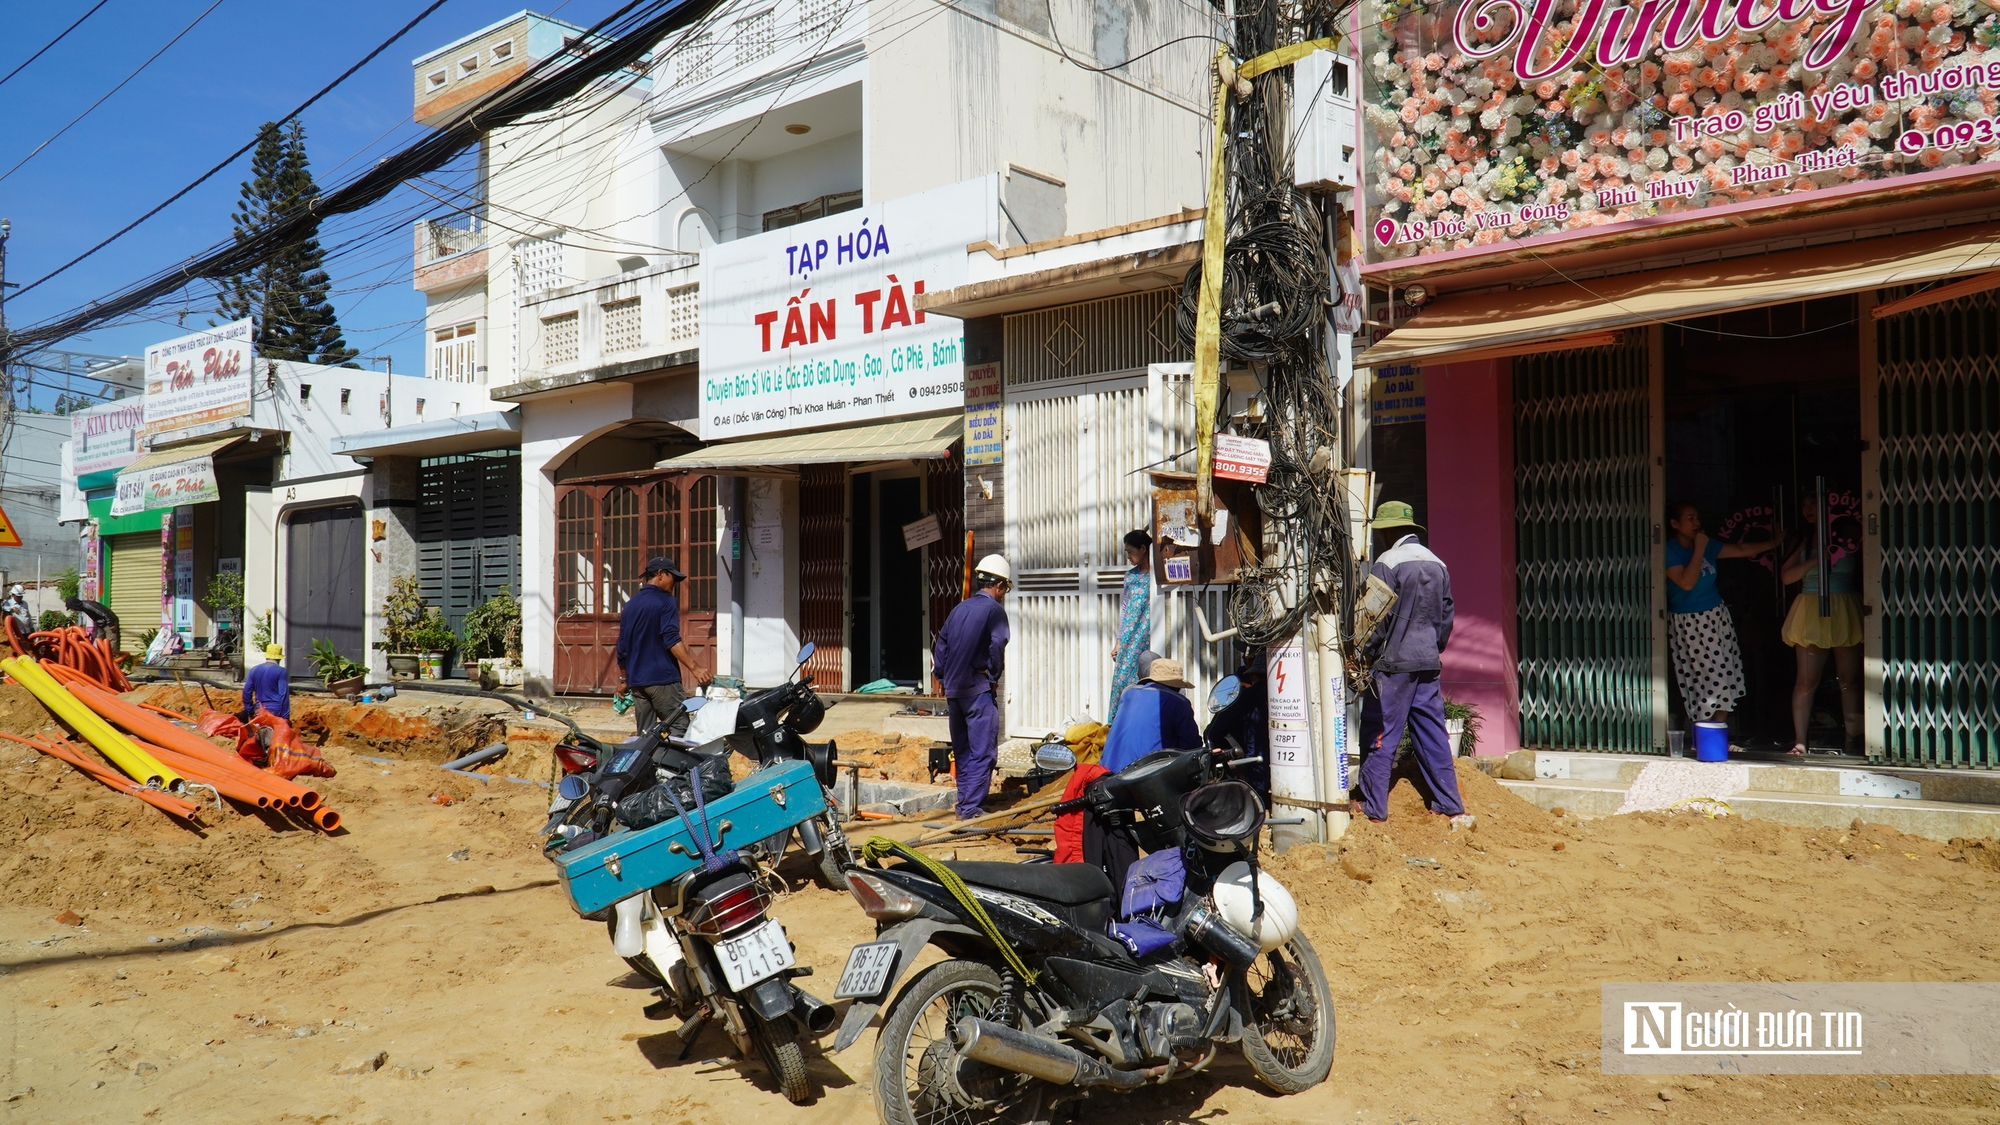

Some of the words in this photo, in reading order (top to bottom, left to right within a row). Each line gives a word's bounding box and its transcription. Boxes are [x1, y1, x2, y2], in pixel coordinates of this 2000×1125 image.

[1672, 110, 1743, 142] Trao
[1754, 92, 1804, 131] gửi
[1812, 85, 1870, 121] yêu
[1936, 117, 2000, 149] 093
[1397, 221, 1425, 243] A8
[1433, 214, 1466, 238] Dốc
[1475, 208, 1511, 230] Văn
[1519, 201, 1568, 222] Công
[1598, 183, 1637, 208] Phú
[1645, 174, 1700, 199] Thủy
[1732, 161, 1788, 185] Phan
[1796, 144, 1857, 173] Thiết
[786, 239, 828, 280] TẠP
[837, 217, 890, 265] HÓA
[754, 287, 836, 353] TẤN
[855, 273, 926, 334] TÀI
[166, 359, 195, 393] Tấn
[203, 347, 241, 385] Phát
[707, 377, 733, 405] Chuyên
[735, 373, 750, 397] Bán
[760, 369, 771, 393] Và
[785, 365, 801, 390] Các
[803, 358, 815, 387] Đồ
[817, 361, 831, 385] Gia
[833, 358, 856, 386] Dụng
[864, 353, 882, 381] Gạo
[891, 346, 903, 373] Cà
[906, 344, 924, 370] Phê
[933, 337, 957, 366] Bánh
[968, 364, 996, 381] CHUYÊN
[804, 403, 824, 414] Khoa
[827, 399, 846, 410] Huân
[853, 396, 872, 407] Phan
[875, 390, 895, 403] Thiết
[965, 386, 980, 399] CHO
[981, 381, 1000, 397] THUÊ
[966, 402, 984, 413] TRANG
[87, 413, 107, 437] KIM
[151, 483, 172, 499] Tấn
[176, 477, 205, 495] Phát
[286, 487, 296, 501] A3
[1718, 511, 1743, 540] Kéo
[1745, 505, 1763, 519] ra
[1275, 734, 1297, 743] 478PT
[1277, 751, 1295, 762] 112
[733, 946, 785, 984] 7415
